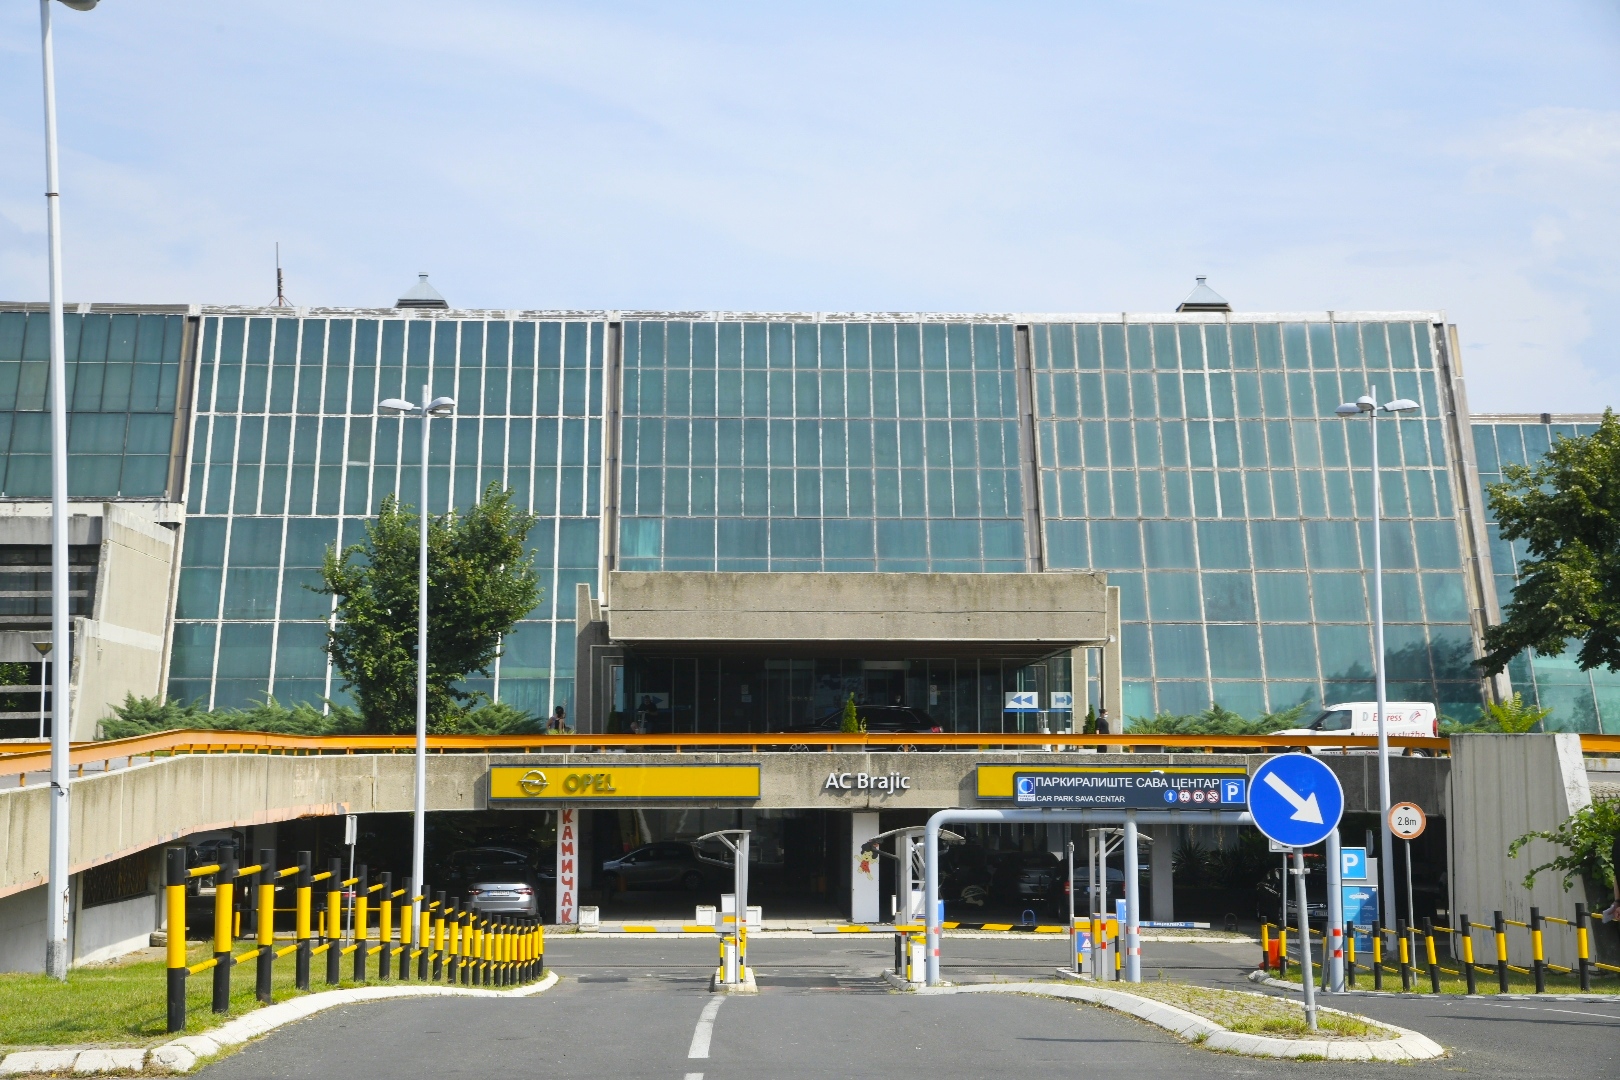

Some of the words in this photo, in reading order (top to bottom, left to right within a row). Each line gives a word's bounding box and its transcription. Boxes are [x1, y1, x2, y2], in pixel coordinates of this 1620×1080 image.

[1373, 712, 1402, 721] Eress
[565, 773, 616, 791] OPEL
[825, 772, 852, 789] AC
[857, 771, 911, 794] Brajic
[1035, 777, 1133, 788] ПАРКИРАЛИШТЕ
[1136, 777, 1168, 788] САВА
[1171, 778, 1220, 790] ЦЕНТАР
[1074, 795, 1094, 803] SAVA
[1095, 795, 1126, 803] CENTAR
[1227, 784, 1239, 801] P
[1397, 816, 1417, 826] 2.8m
[561, 808, 574, 924] КАМИЧАК
[1342, 853, 1359, 874] P
